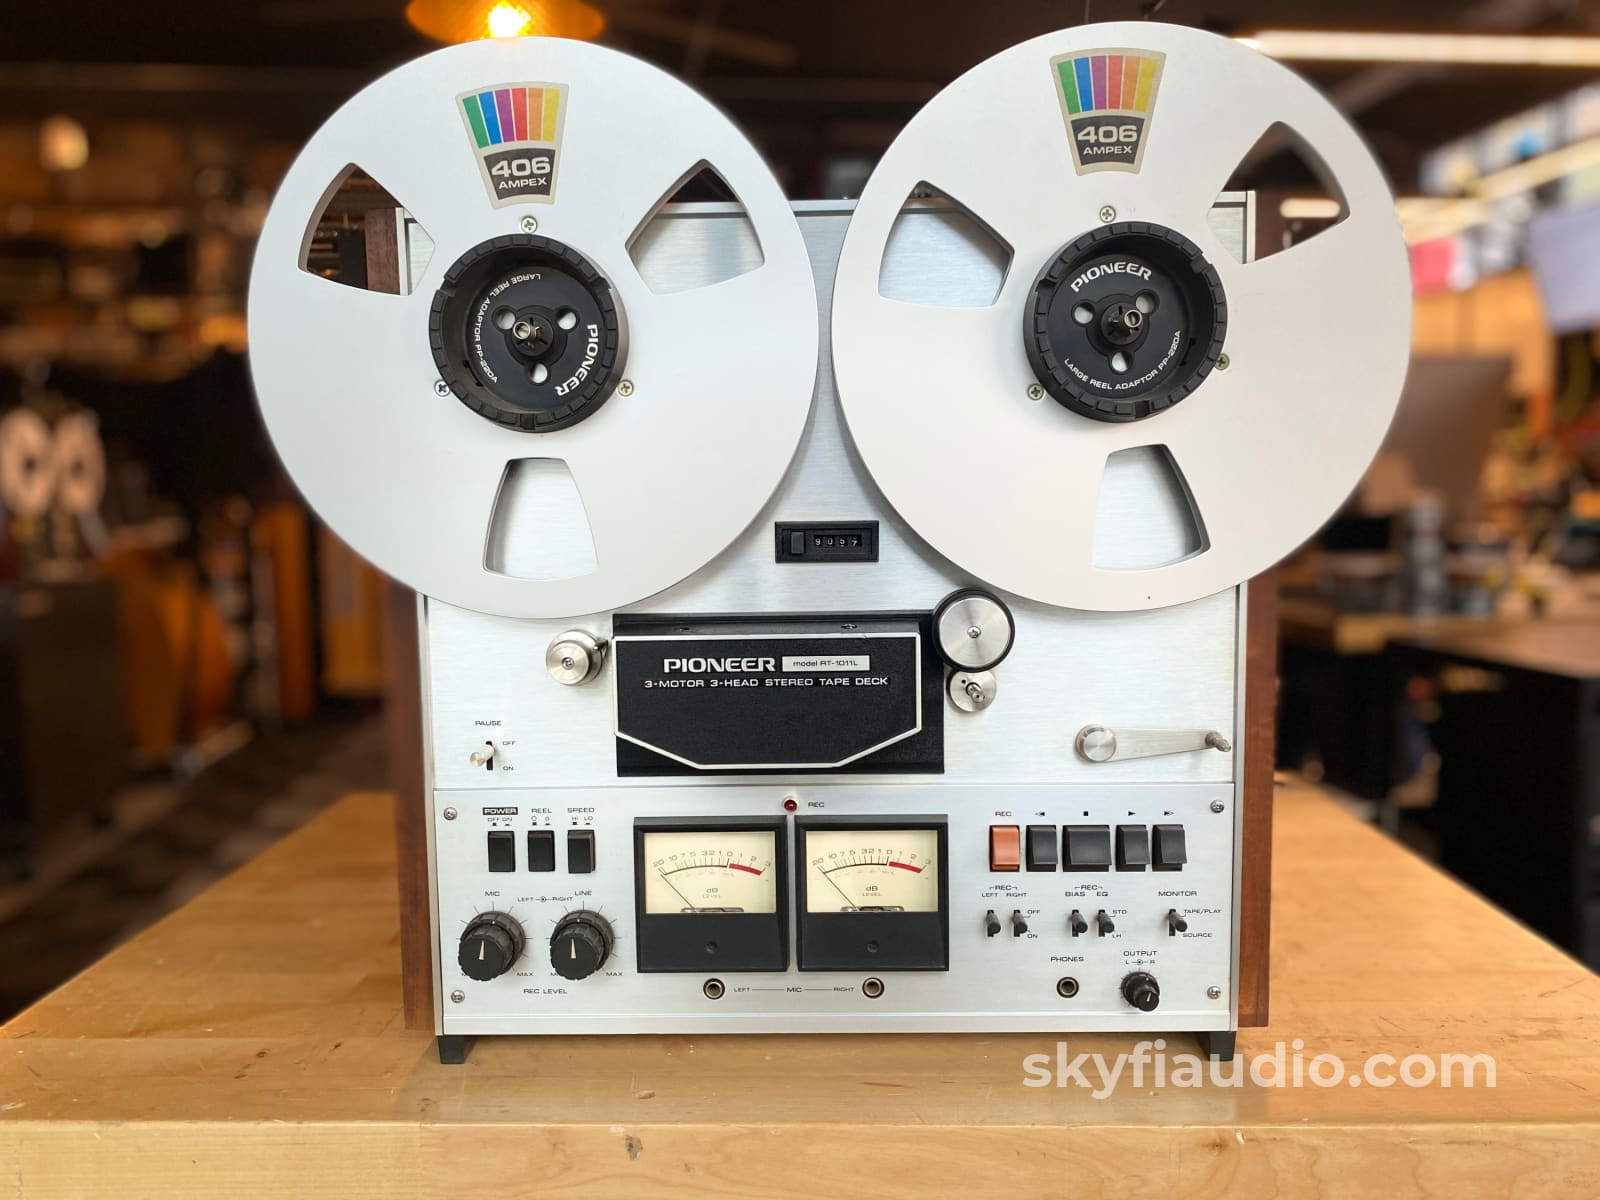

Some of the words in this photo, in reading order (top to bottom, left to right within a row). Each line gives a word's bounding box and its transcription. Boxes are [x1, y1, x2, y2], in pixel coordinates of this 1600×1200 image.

[1077, 125, 1138, 144] 406
[1083, 145, 1132, 155] AMPEX
[491, 156, 551, 178] 406
[498, 177, 547, 190] AMPEX
[510, 273, 542, 284] LARGE
[1070, 261, 1153, 293] PIONEER
[490, 280, 511, 298] REEL
[474, 297, 491, 342] ADAPTOR
[555, 323, 600, 396] PIONEER
[1064, 357, 1088, 383] LARGE
[1089, 378, 1113, 390] REEL
[1114, 369, 1159, 390] ADAPTOR
[1158, 330, 1181, 371] PP-220A
[663, 657, 776, 673] PIONEER
[792, 660, 818, 668] model
[819, 660, 859, 668] RT-1011L
[644, 680, 705, 688] 3-MOTOR
[710, 679, 759, 687] 3-HEAD
[764, 678, 814, 687] STEREO
[818, 678, 850, 686] TAPE
[855, 676, 888, 686] DECK
